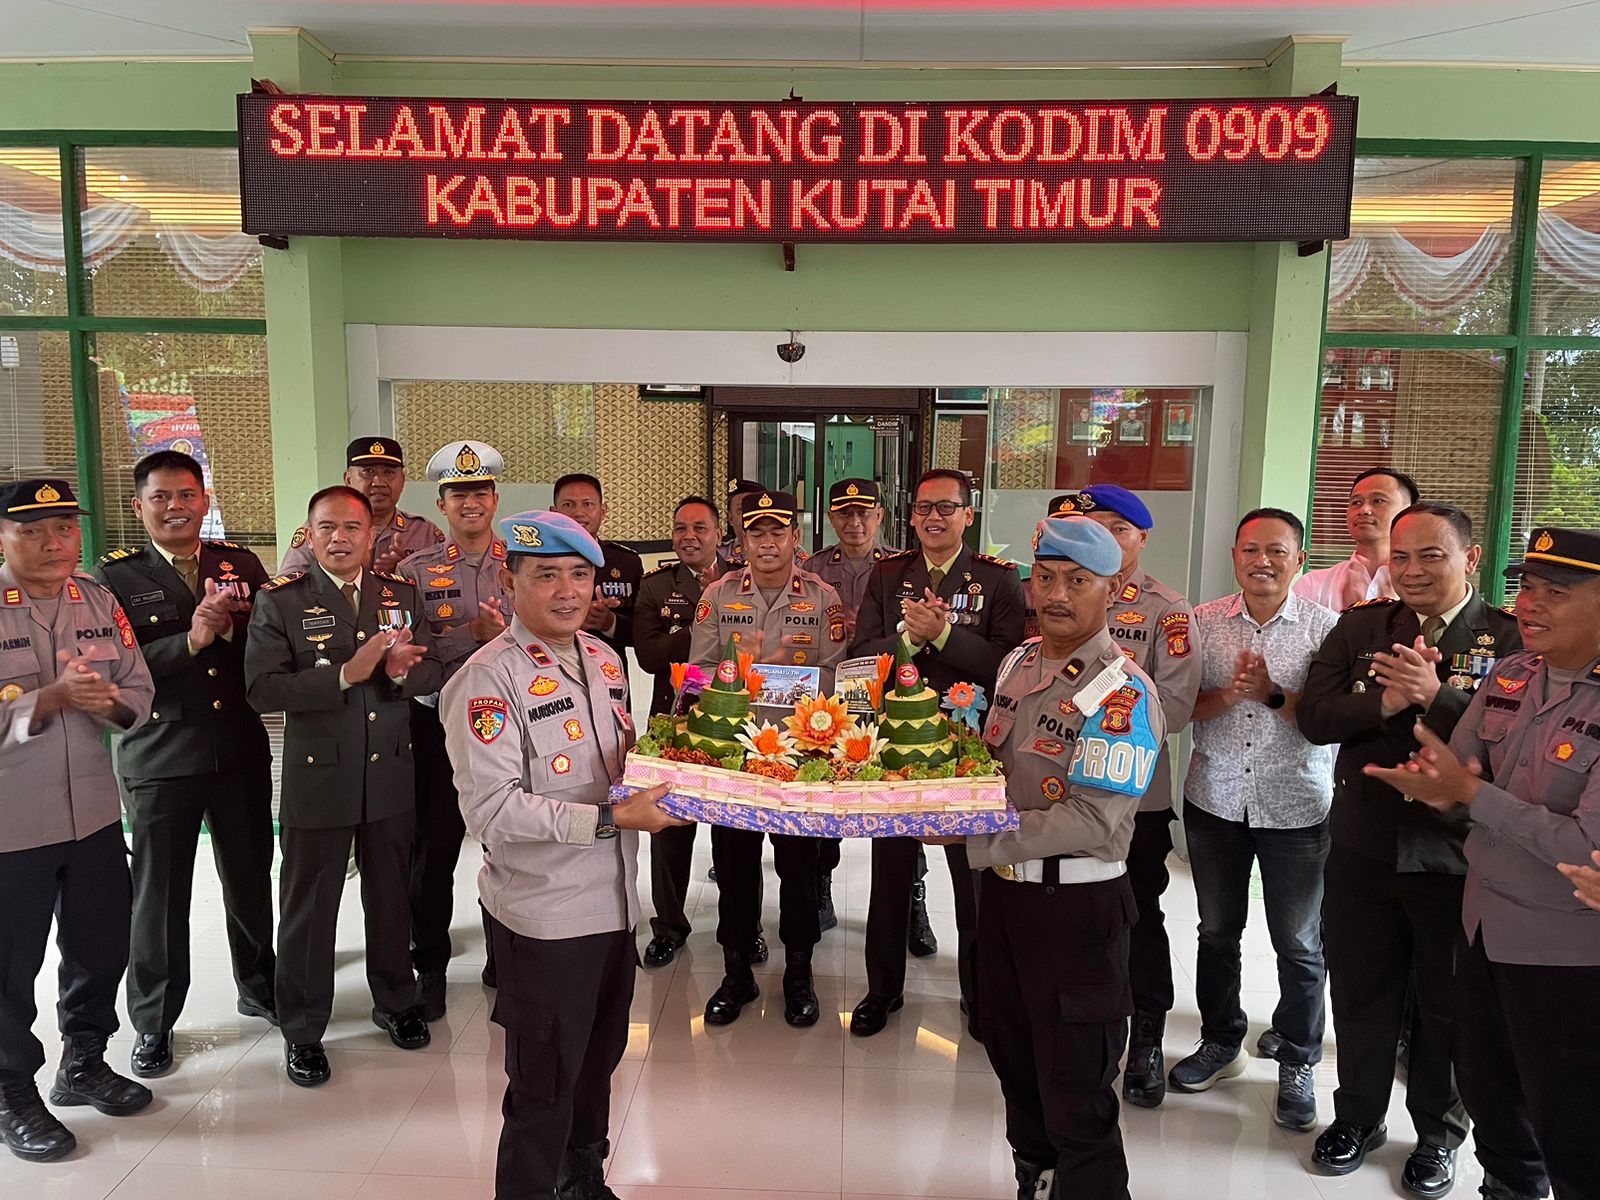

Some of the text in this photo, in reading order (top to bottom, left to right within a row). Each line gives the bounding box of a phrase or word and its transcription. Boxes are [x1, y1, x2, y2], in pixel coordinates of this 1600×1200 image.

[269, 103, 1332, 164] SELAMAT DATANG DI KODIM 0909
[425, 173, 1164, 230] KABUPATEN KUTAI TIMUR
[721, 614, 754, 625] AHMAD
[785, 616, 819, 626] POLRI
[76, 628, 113, 640] POLRI
[1108, 628, 1148, 641] POLRI
[473, 699, 504, 708] PROPAM
[527, 697, 575, 723] NURKHOLIS
[1067, 737, 1156, 789] PROV
